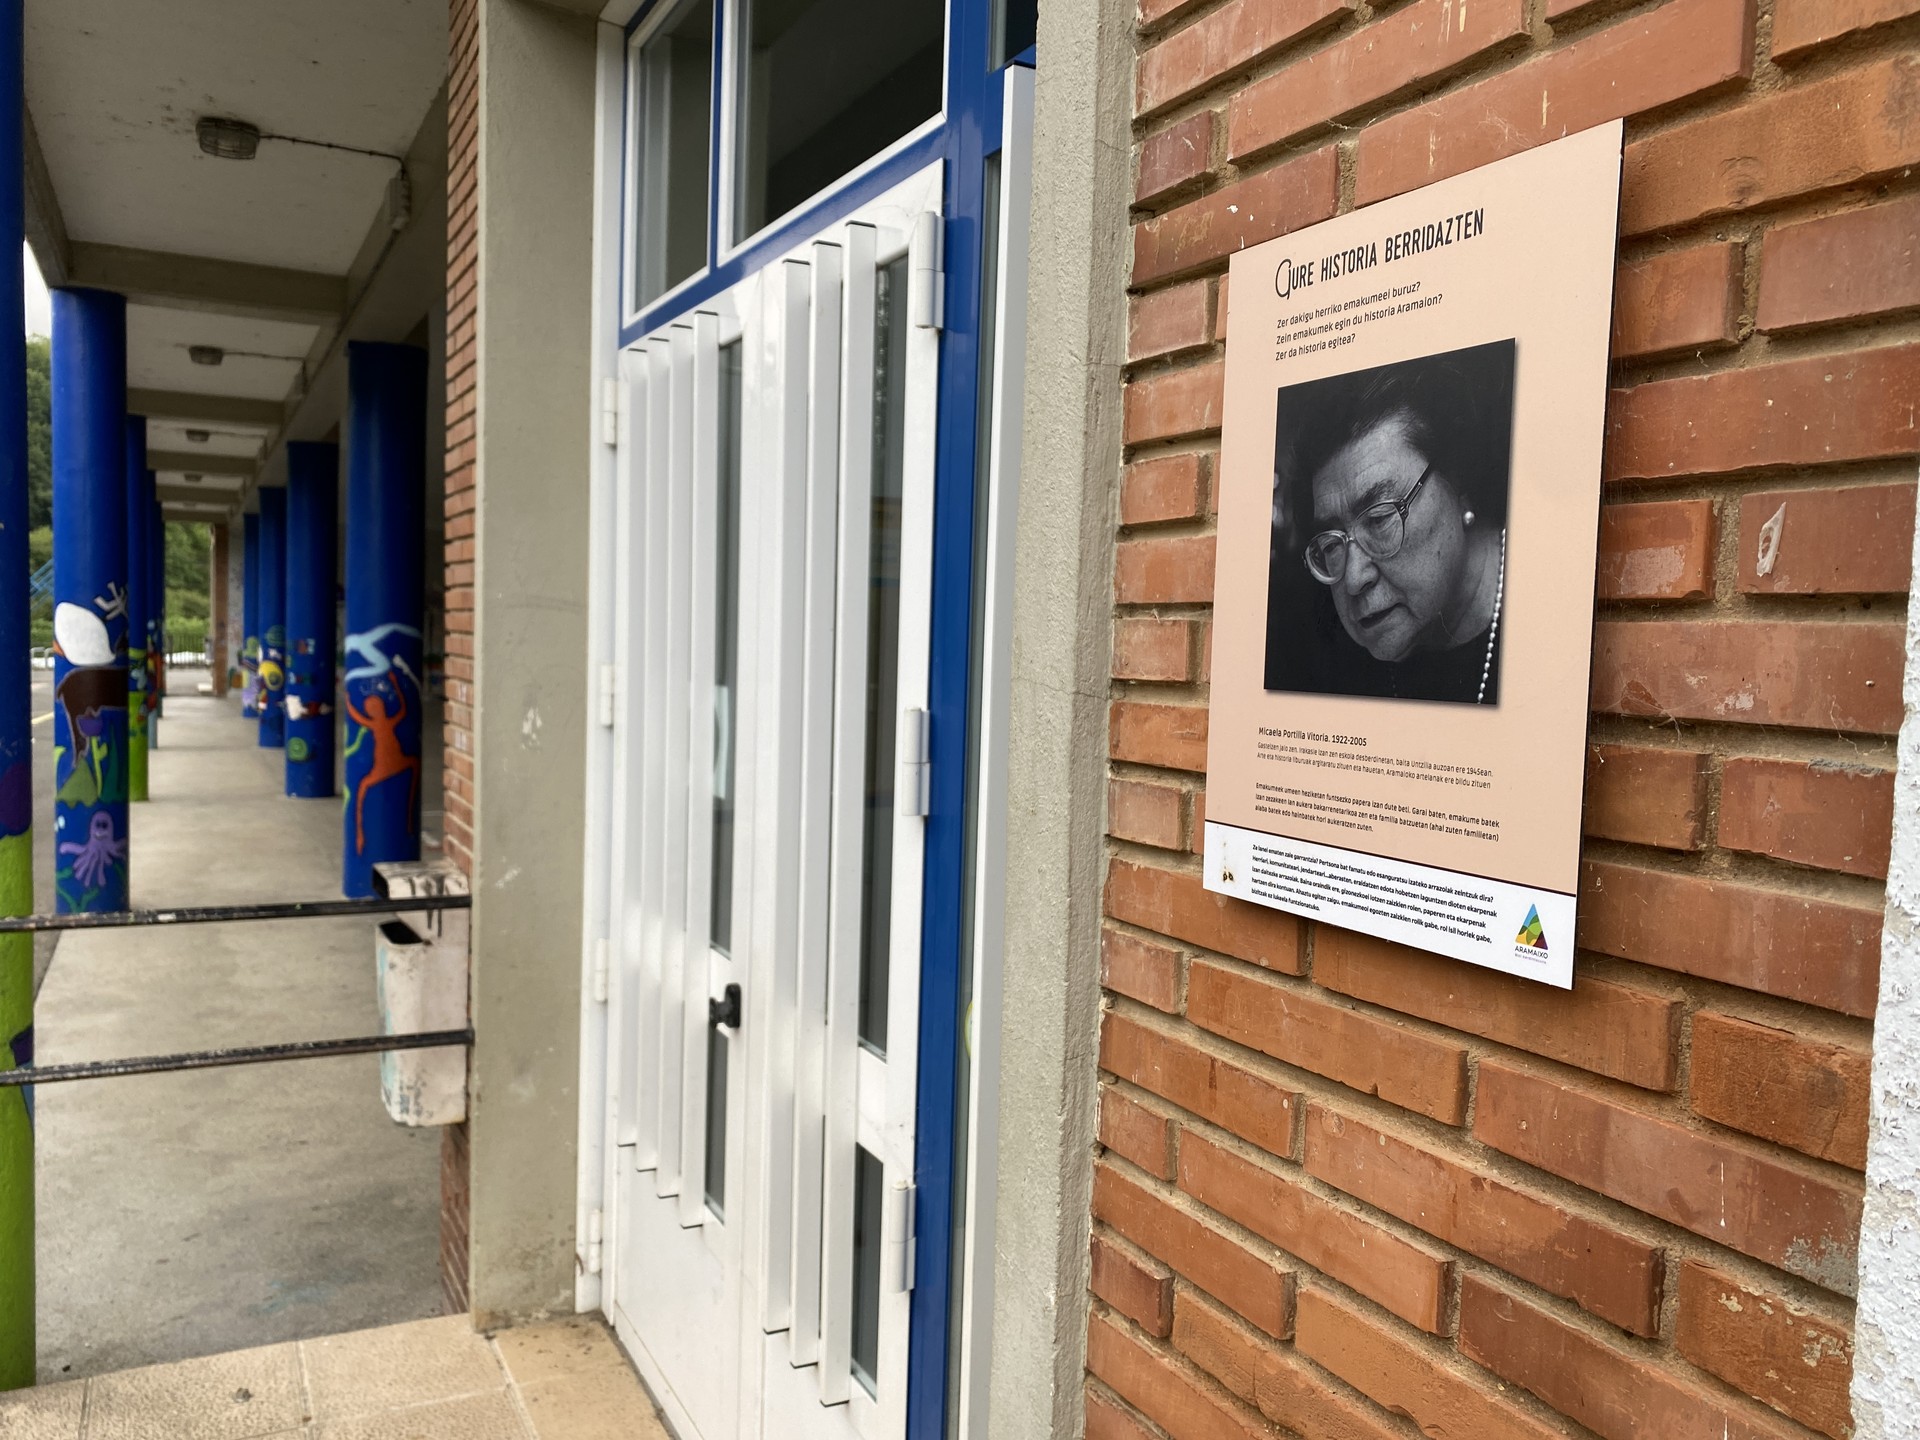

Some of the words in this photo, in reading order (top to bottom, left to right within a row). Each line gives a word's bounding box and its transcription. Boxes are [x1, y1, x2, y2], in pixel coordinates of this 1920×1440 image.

[1320, 241, 1377, 282] HISTORIA
[1384, 207, 1484, 263] BERRIDAZTEN
[1275, 332, 1292, 345] Zein
[1292, 321, 1334, 341] emakumek
[1334, 317, 1351, 331] egin
[1352, 314, 1363, 326] du
[1363, 305, 1395, 323] historia
[1396, 293, 1443, 314] Aramaion?
[1276, 318, 1289, 329] Zer
[1289, 311, 1314, 325] dakigu
[1314, 303, 1342, 318] herriko
[1343, 288, 1391, 311] emakumeei
[1392, 280, 1421, 298] buruz?
[1275, 350, 1288, 361] Zer
[1288, 347, 1297, 358] da
[1298, 340, 1326, 356] historia
[1327, 332, 1356, 350] egitea?
[1258, 726, 1282, 737] Micaela
[1282, 729, 1306, 740] Portilla
[1306, 731, 1330, 743] Vitoria.
[1331, 734, 1367, 747] 1922-2005
[1254, 804, 1268, 813] alaba
[1267, 806, 1281, 815] batek
[1291, 810, 1316, 821] hainbatek
[1315, 814, 1326, 823] hori
[1326, 817, 1356, 829] aukeratzen
[1356, 823, 1373, 832] zuten.
[1255, 782, 1284, 793] Emakumeek
[1284, 787, 1301, 795] umeen
[1301, 789, 1325, 799] heziketan
[1325, 793, 1352, 804] funtsezko
[1351, 798, 1371, 807] papera
[1371, 800, 1383, 809] izan
[1383, 802, 1397, 812] dute
[1397, 804, 1411, 814] beti.
[1411, 806, 1428, 816] Garai
[1428, 809, 1447, 820] baten,
[1448, 813, 1480, 825] emakume
[1480, 817, 1500, 828] batek
[1255, 793, 1265, 801] izan
[1265, 795, 1287, 804] zezakeen
[1295, 800, 1313, 809] aukera
[1313, 802, 1358, 817] bakarrenetarikoa
[1398, 817, 1428, 829] batzuetan
[1428, 822, 1445, 832] (ahal
[1444, 826, 1463, 835] zuten
[1514, 945, 1549, 959] ARAMAIXO
